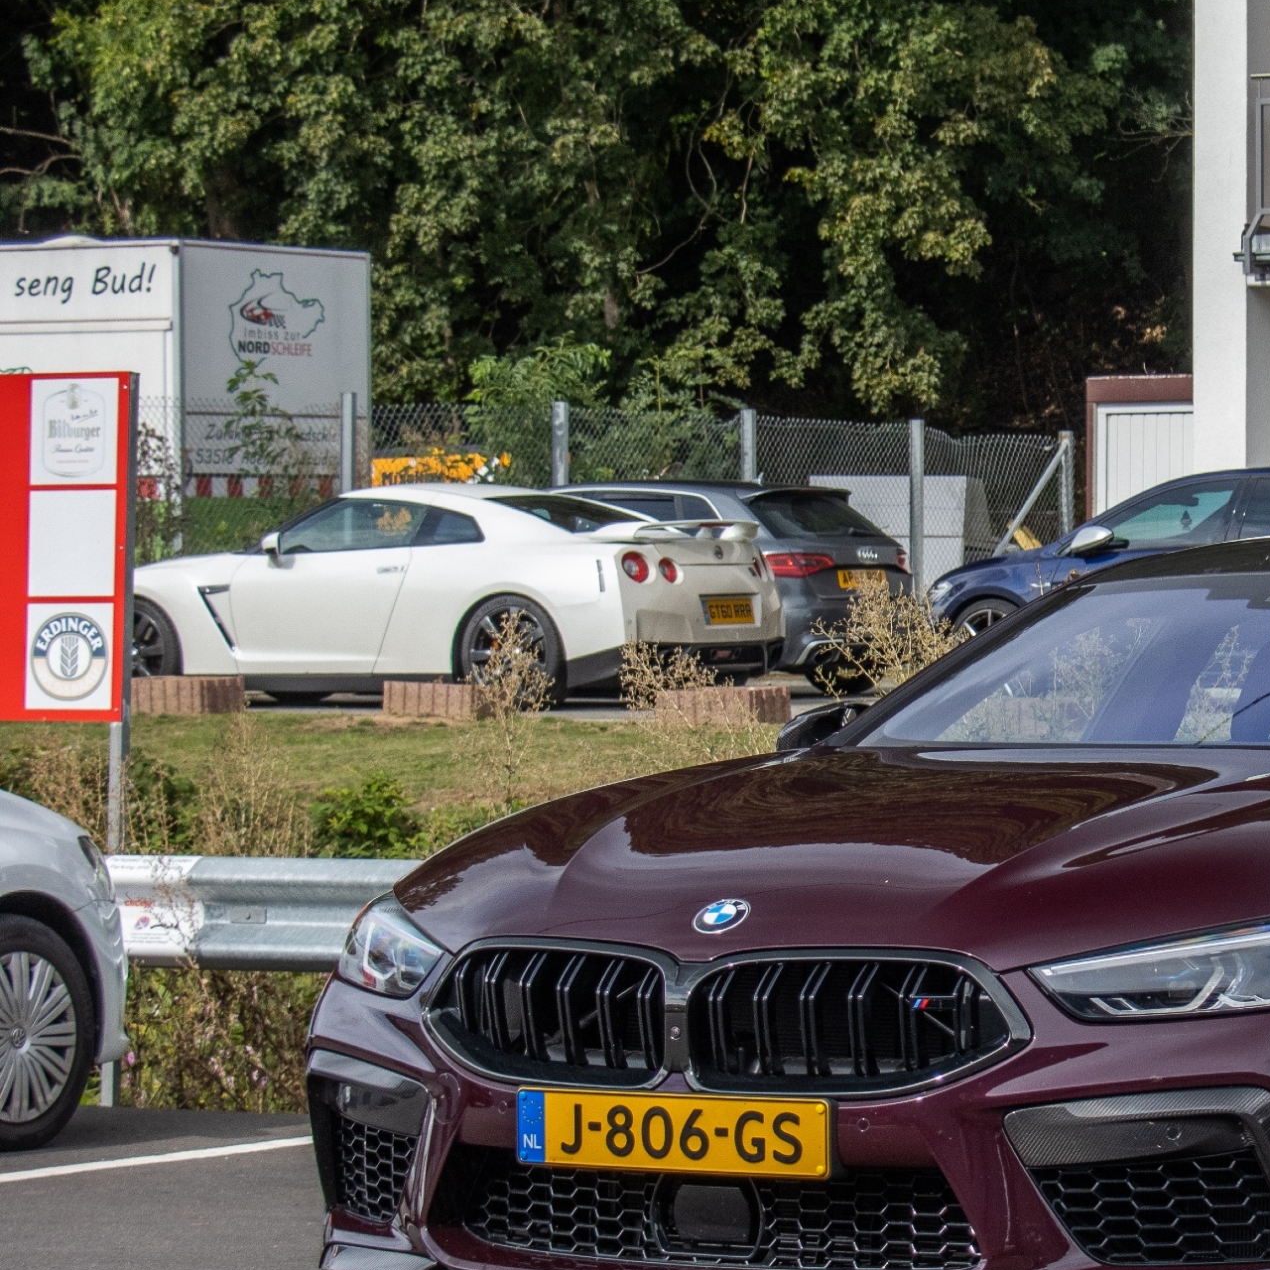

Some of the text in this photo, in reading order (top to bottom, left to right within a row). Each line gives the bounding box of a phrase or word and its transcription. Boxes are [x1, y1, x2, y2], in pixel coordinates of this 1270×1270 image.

[15, 262, 156, 304] seng Bud!
[238, 340, 313, 357] NORDSCHLEIFE
[36, 617, 104, 651] ERDINGER
[523, 1133, 542, 1150] NL
[561, 1103, 803, 1164] J-806-GS
